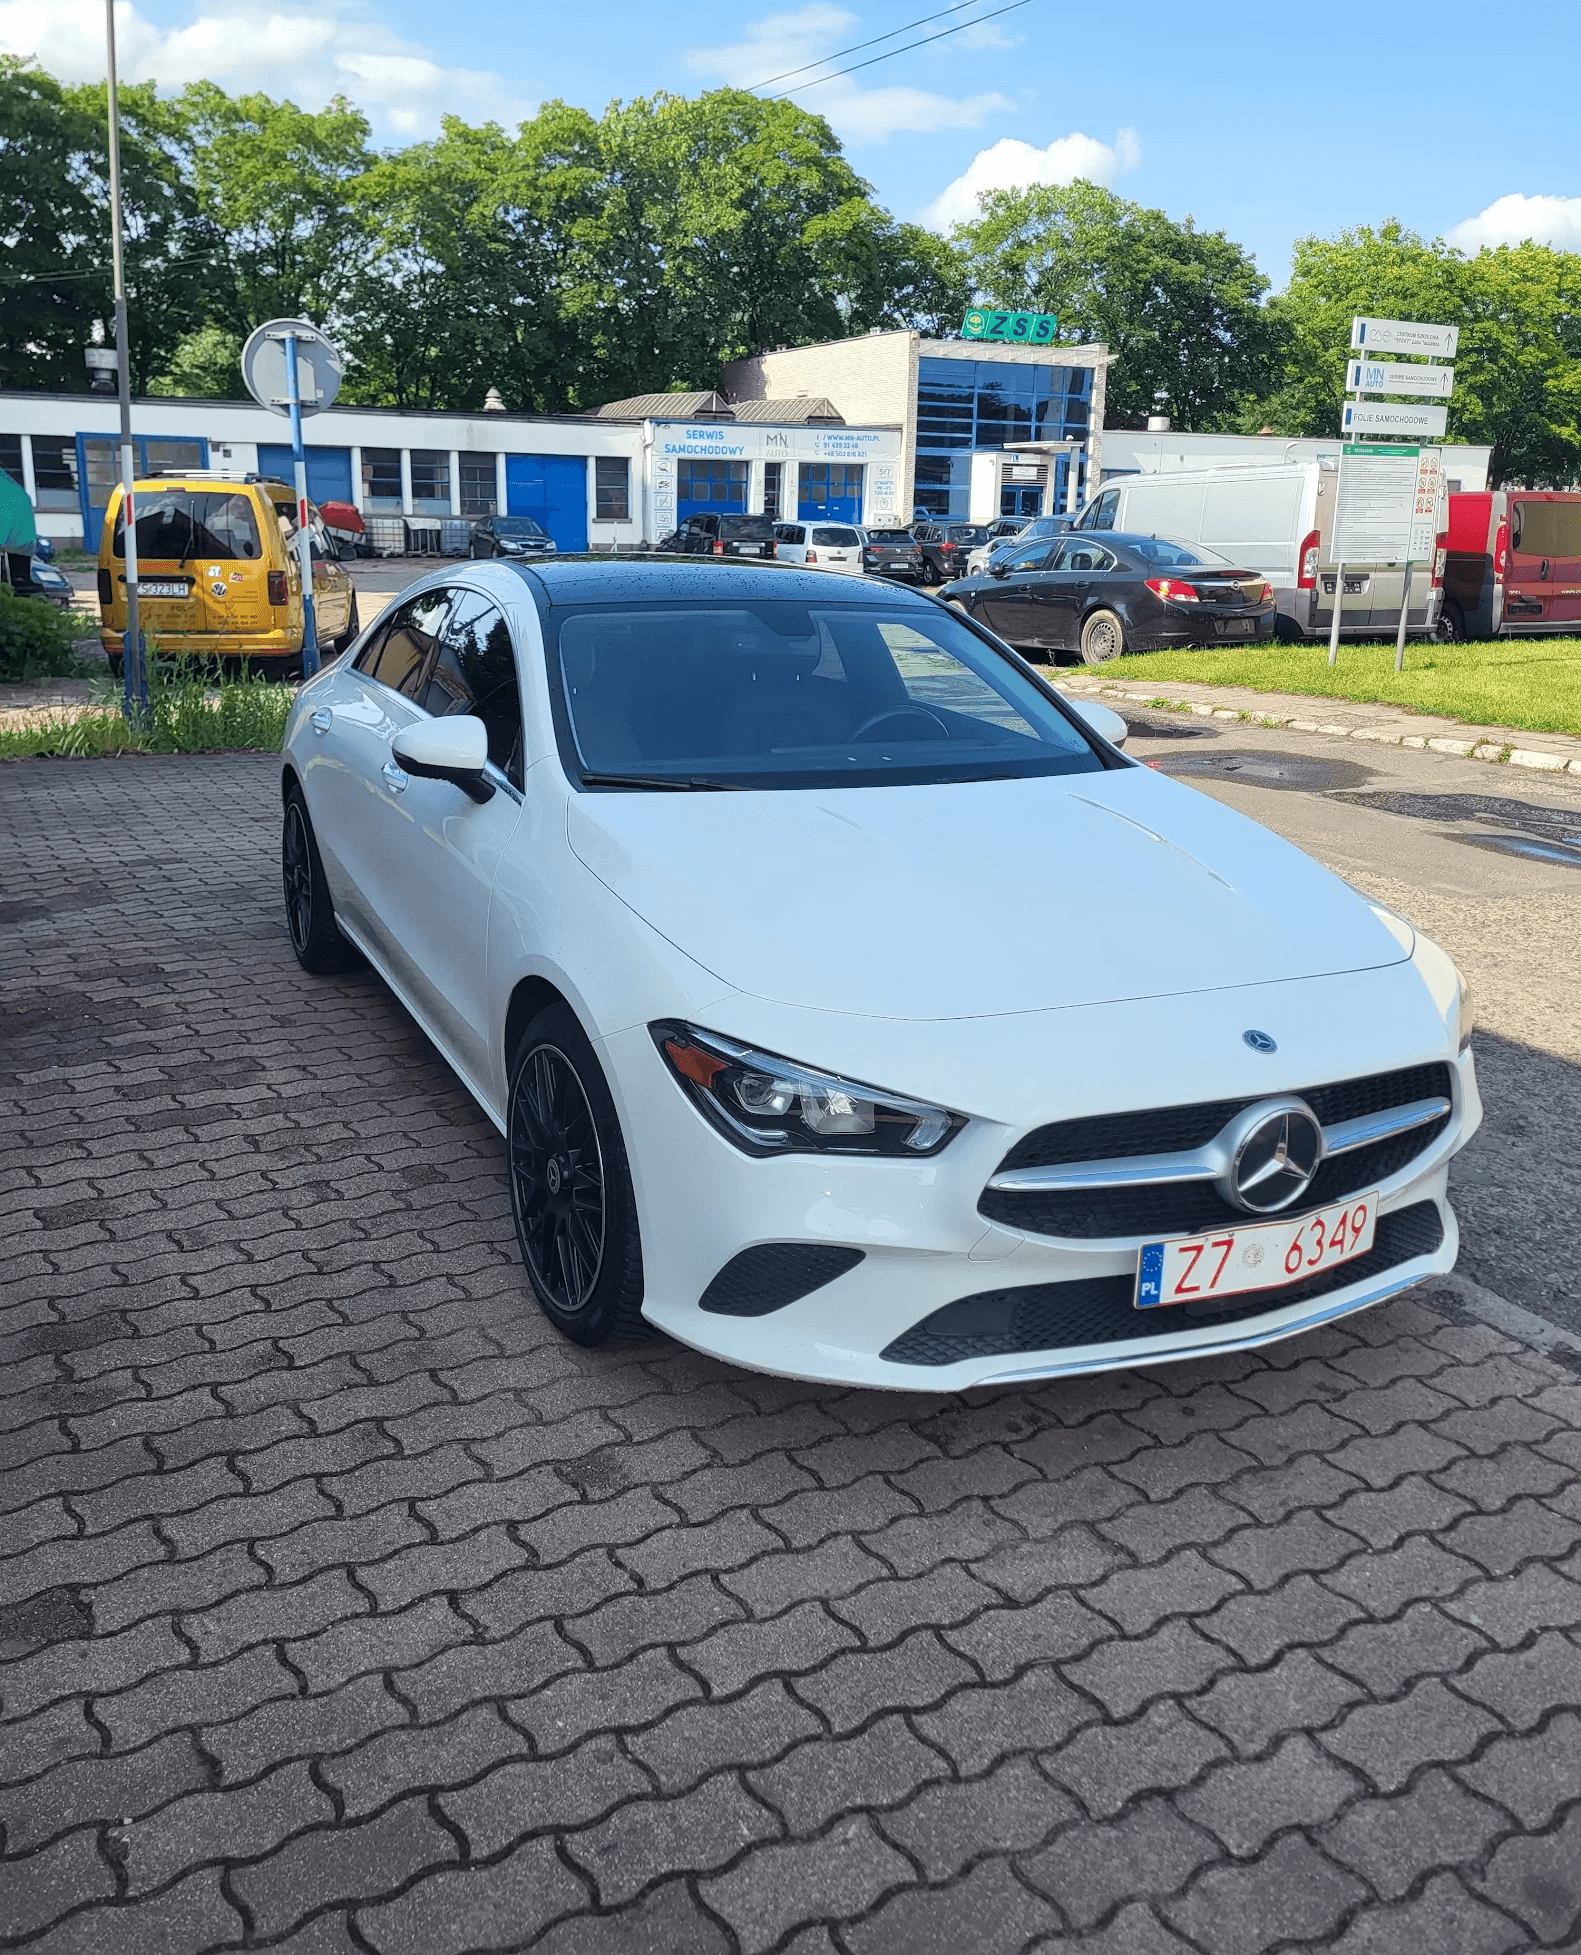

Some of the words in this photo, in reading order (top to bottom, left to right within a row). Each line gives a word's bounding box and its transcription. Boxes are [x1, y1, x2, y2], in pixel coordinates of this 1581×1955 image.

[989, 315, 1051, 338] ZSS
[1366, 367, 1385, 380] MN
[1365, 380, 1384, 388] AUTO
[1353, 413, 1373, 422] FOLIE
[1375, 414, 1429, 425] SAMOCHODOWE
[685, 429, 725, 440] SERWIS
[766, 431, 788, 448] MN
[664, 443, 745, 456] SAMOCHODOWY
[766, 449, 788, 458] AUTO
[151, 583, 186, 595] 323LH
[1174, 1238, 1235, 1295] Z7
[1284, 1204, 1368, 1275] 6349
[1140, 1281, 1159, 1297] PL
